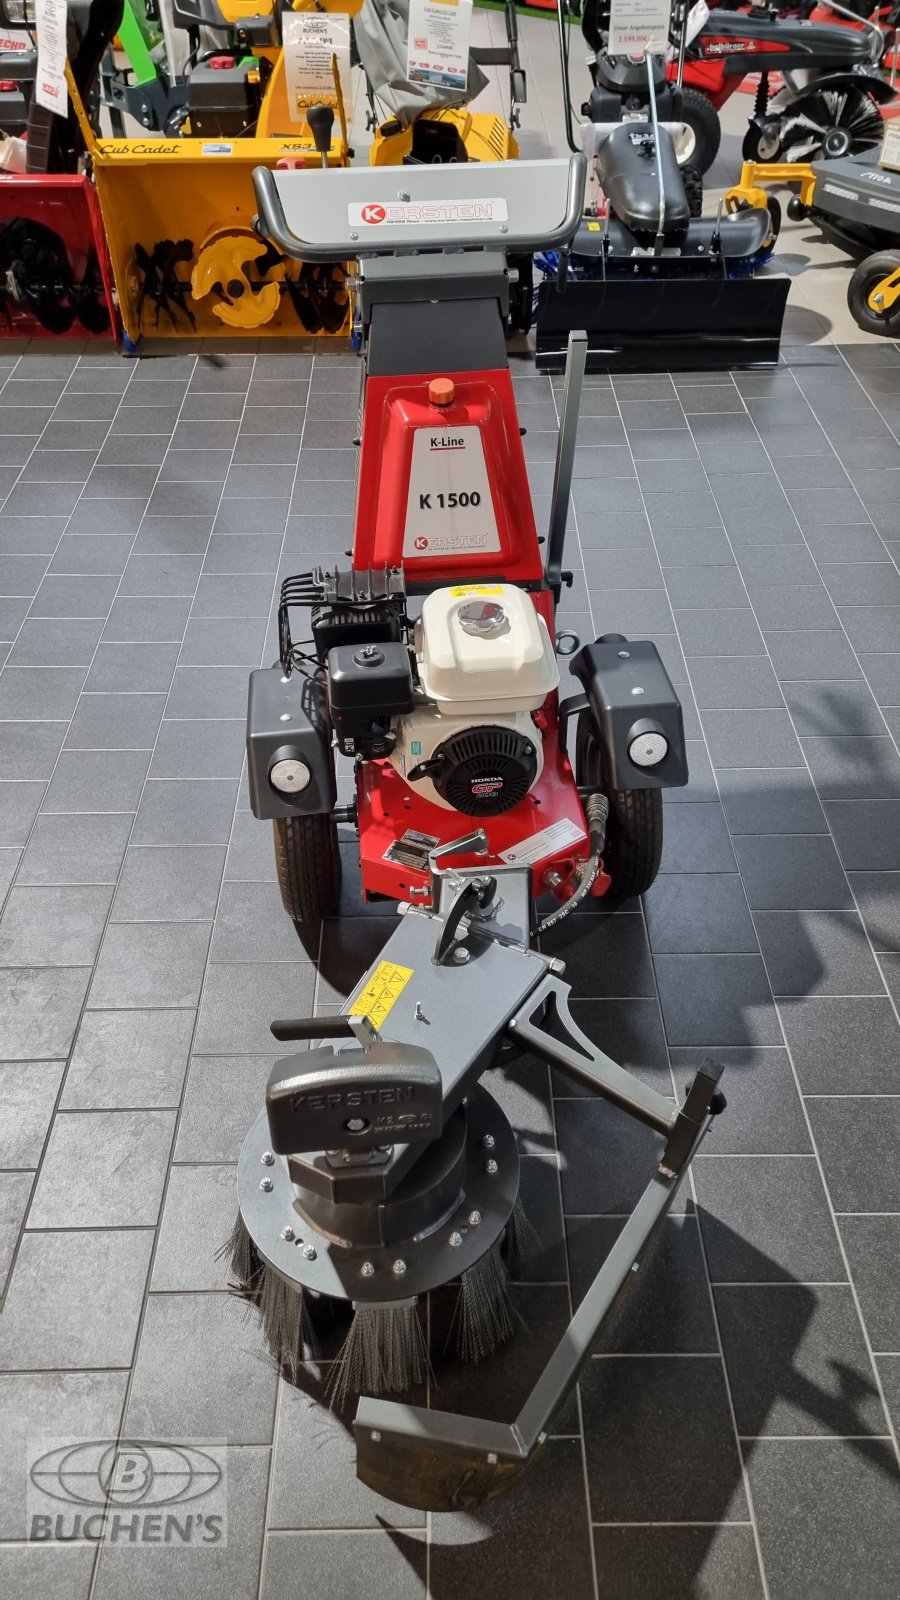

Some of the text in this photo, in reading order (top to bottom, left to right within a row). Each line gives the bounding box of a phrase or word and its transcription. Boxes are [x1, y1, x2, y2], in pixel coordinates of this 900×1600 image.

[100, 144, 182, 154] Cub Cadet
[361, 203, 494, 225] KERSTEN
[430, 437, 464, 447] K-Line
[419, 491, 481, 509] K 1500
[414, 534, 487, 551] KERSTEN
[289, 1086, 414, 1112] KERSTEN
